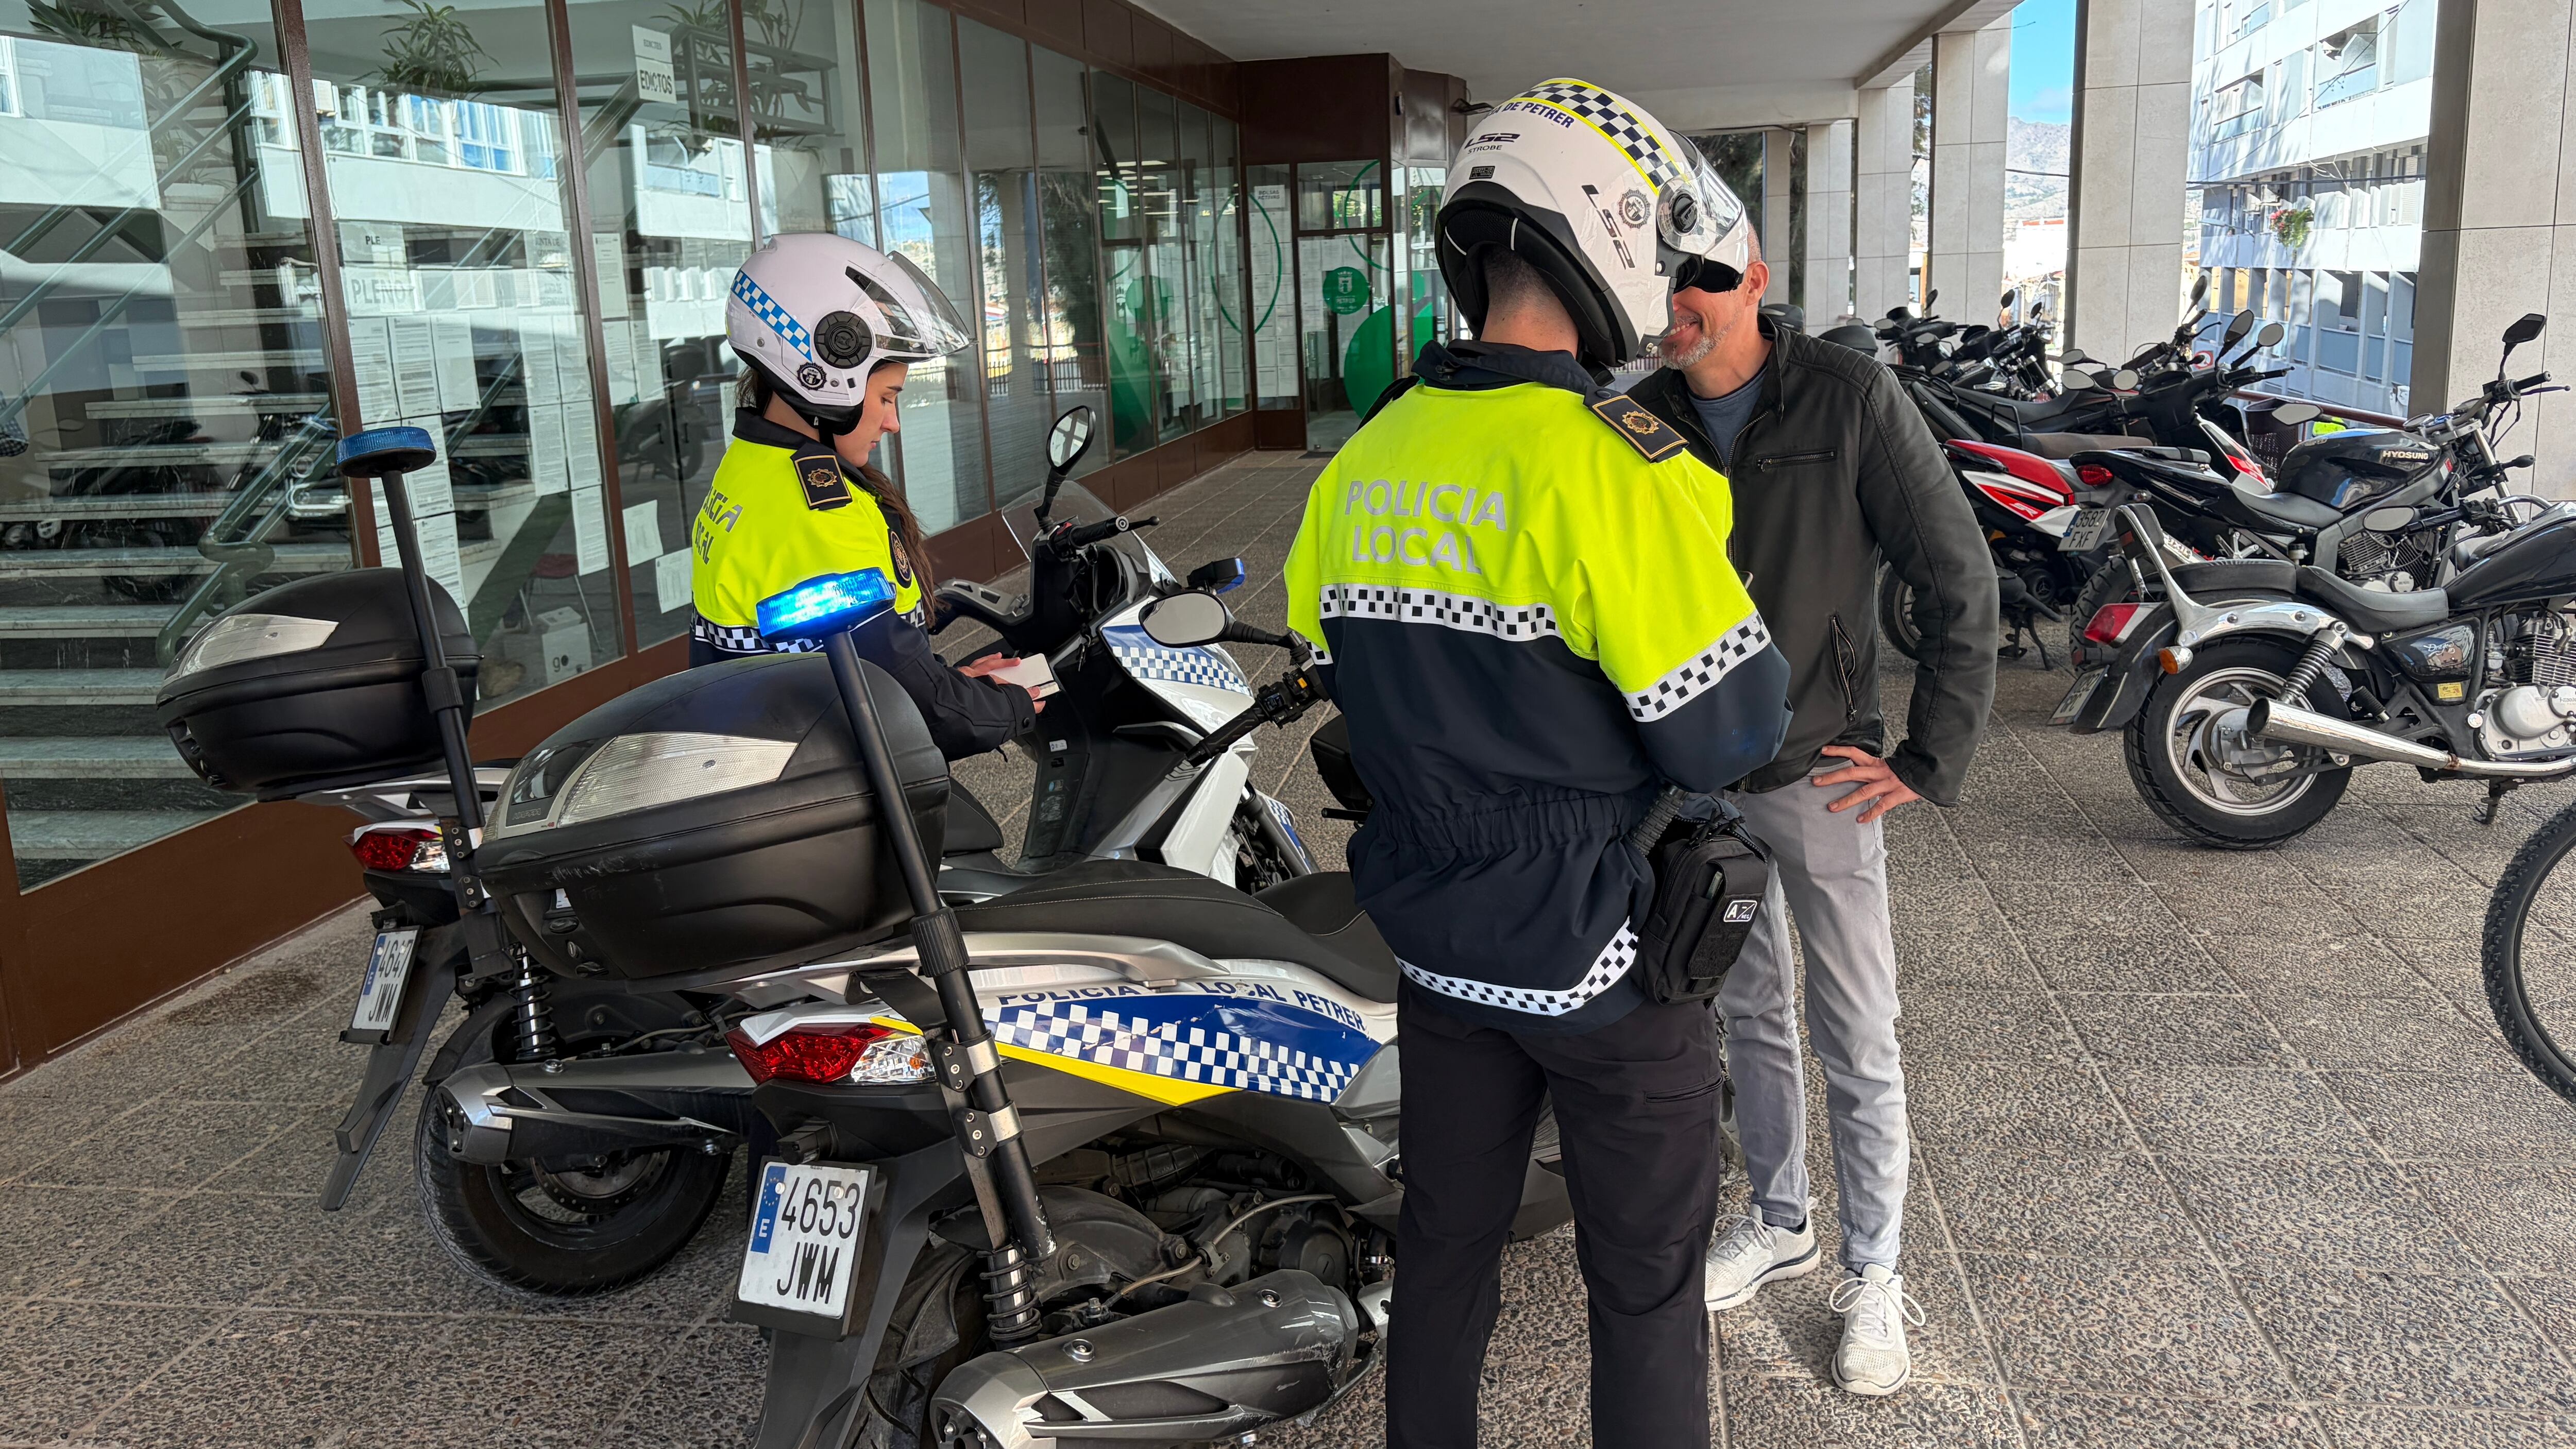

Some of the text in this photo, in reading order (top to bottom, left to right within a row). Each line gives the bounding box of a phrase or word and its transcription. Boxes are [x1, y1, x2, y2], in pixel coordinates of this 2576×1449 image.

[639, 69, 672, 94] EDICTOS
[1502, 101, 1522, 113] DE
[1521, 102, 1575, 129] PETRER
[1464, 132, 1521, 149] LS2
[1467, 145, 1503, 155] STROBE
[1581, 184, 1635, 270] LS2
[365, 235, 381, 245] PLE
[351, 279, 406, 304] PLENO
[2383, 450, 2429, 460] HYOSUNG
[1345, 479, 1506, 531] POLICIA
[2076, 510, 2106, 527] 3587
[1352, 525, 1482, 574] LOCAL
[2069, 531, 2093, 548] FXF
[378, 939, 414, 978] 4647
[367, 971, 374, 985] E
[368, 983, 398, 1022] JWM
[996, 985, 1142, 1005] POLICIA
[1292, 989, 1367, 1032] PETRER
[781, 1177, 860, 1239] 4653
[758, 1218, 770, 1238] E
[776, 1242, 840, 1304] JWM
